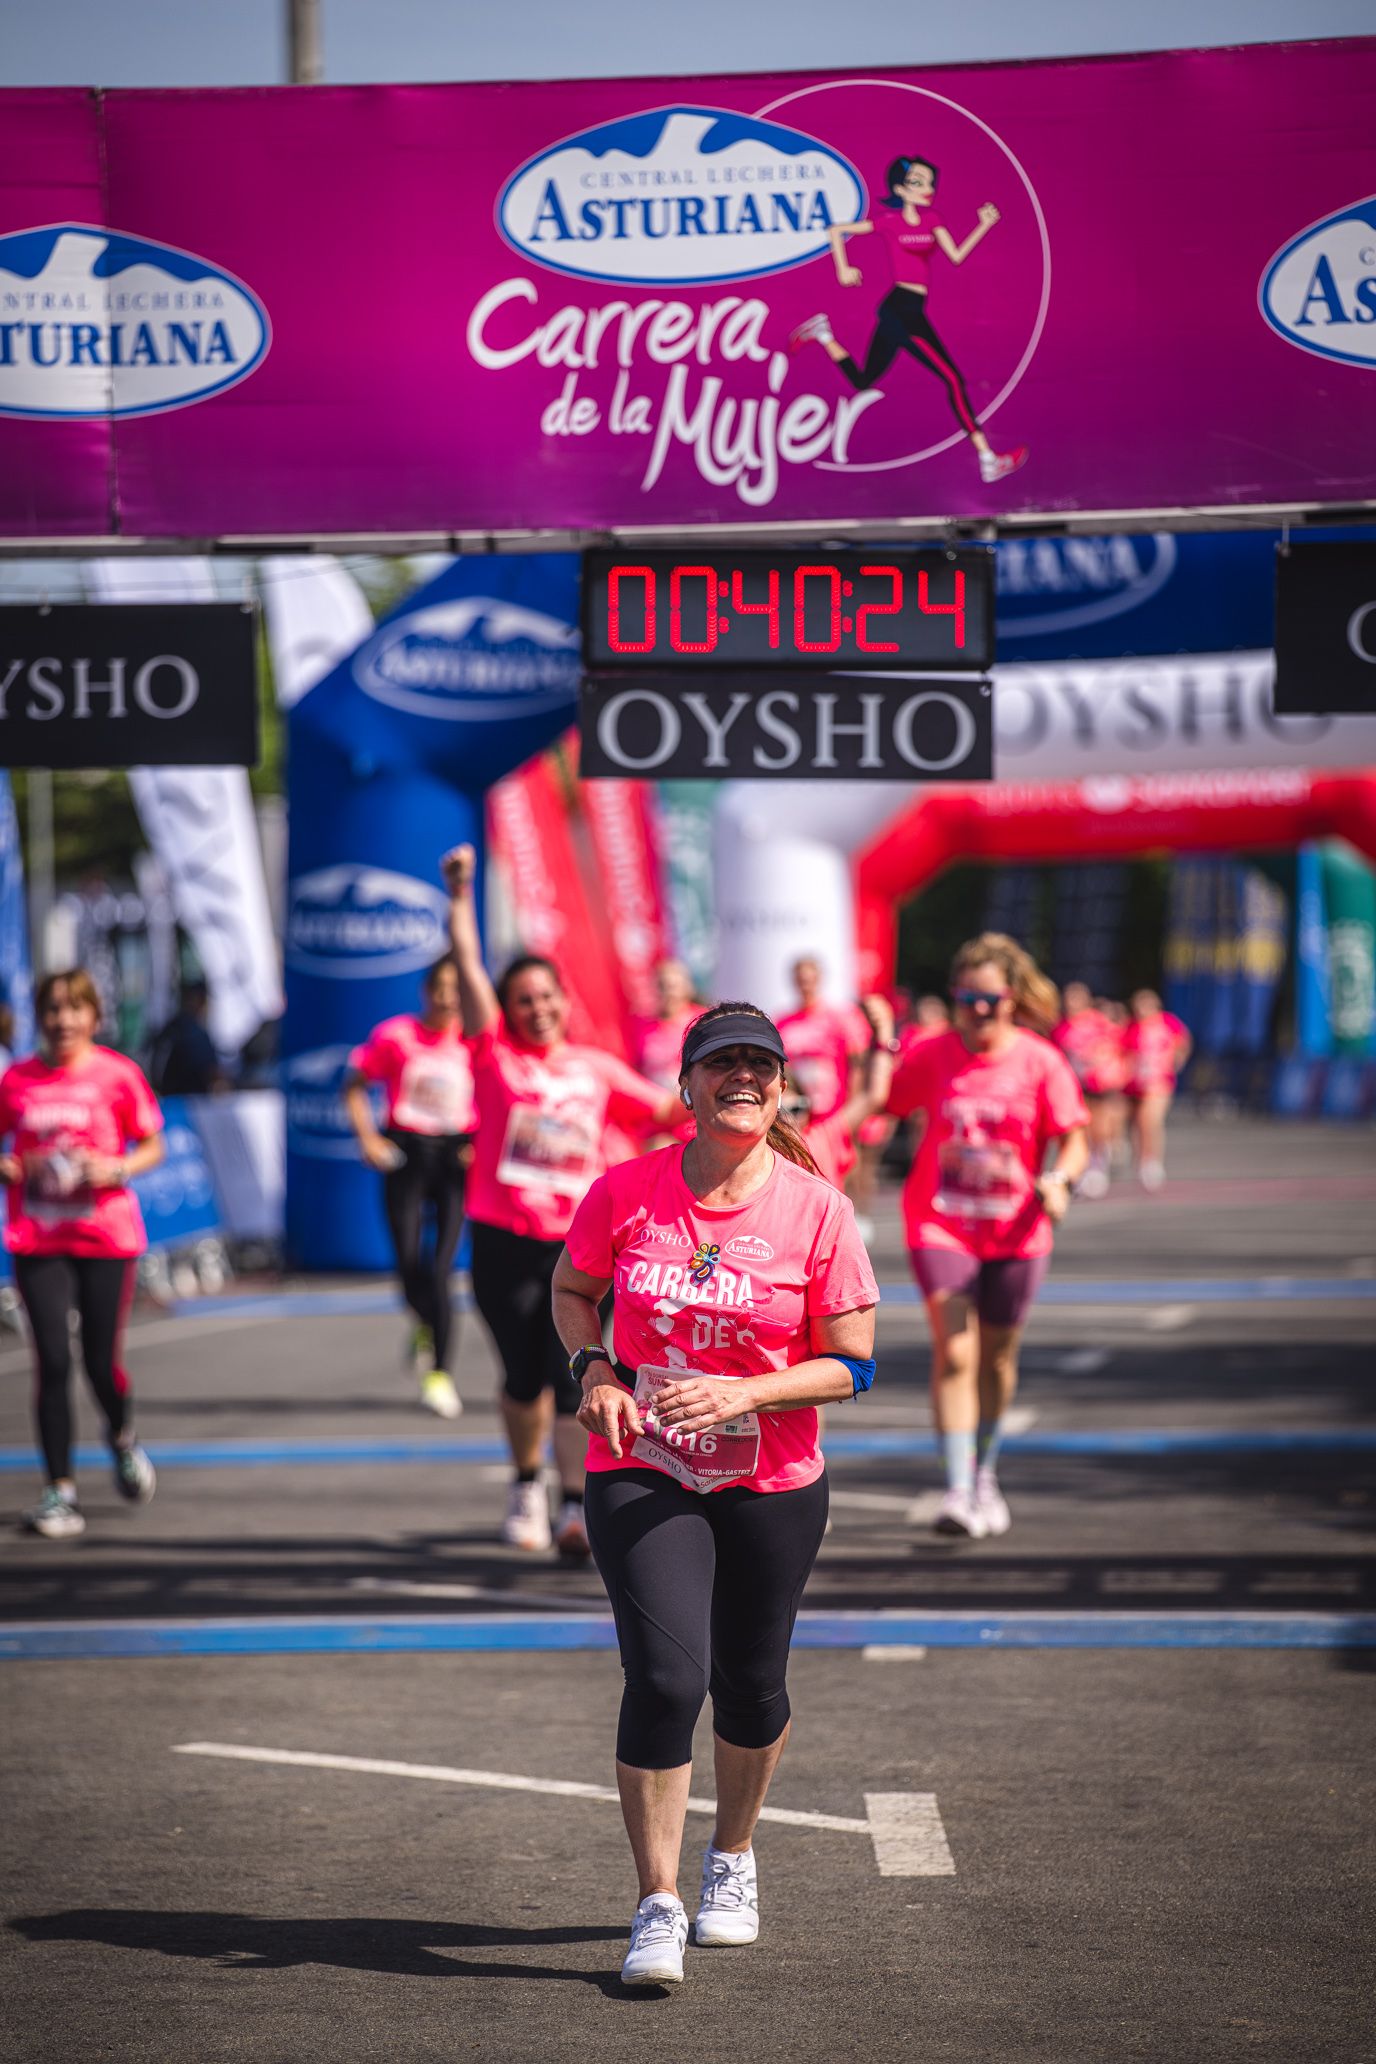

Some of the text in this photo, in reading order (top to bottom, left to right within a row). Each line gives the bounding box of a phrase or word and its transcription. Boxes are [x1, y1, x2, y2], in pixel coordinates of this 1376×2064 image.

[580, 164, 826, 189] CENTRAL LECHERA
[528, 178, 833, 242] ASTURIANA
[104, 290, 225, 311] LECHERA
[466, 277, 770, 371] Carrera
[541, 351, 885, 507] de la Mujer
[608, 565, 966, 653] 00:40:24
[596, 689, 977, 771] OYSHO
[640, 1229, 692, 1249] OYSHO
[728, 1241, 771, 1258] ASTURIANA
[648, 1447, 682, 1474] OYSHO
